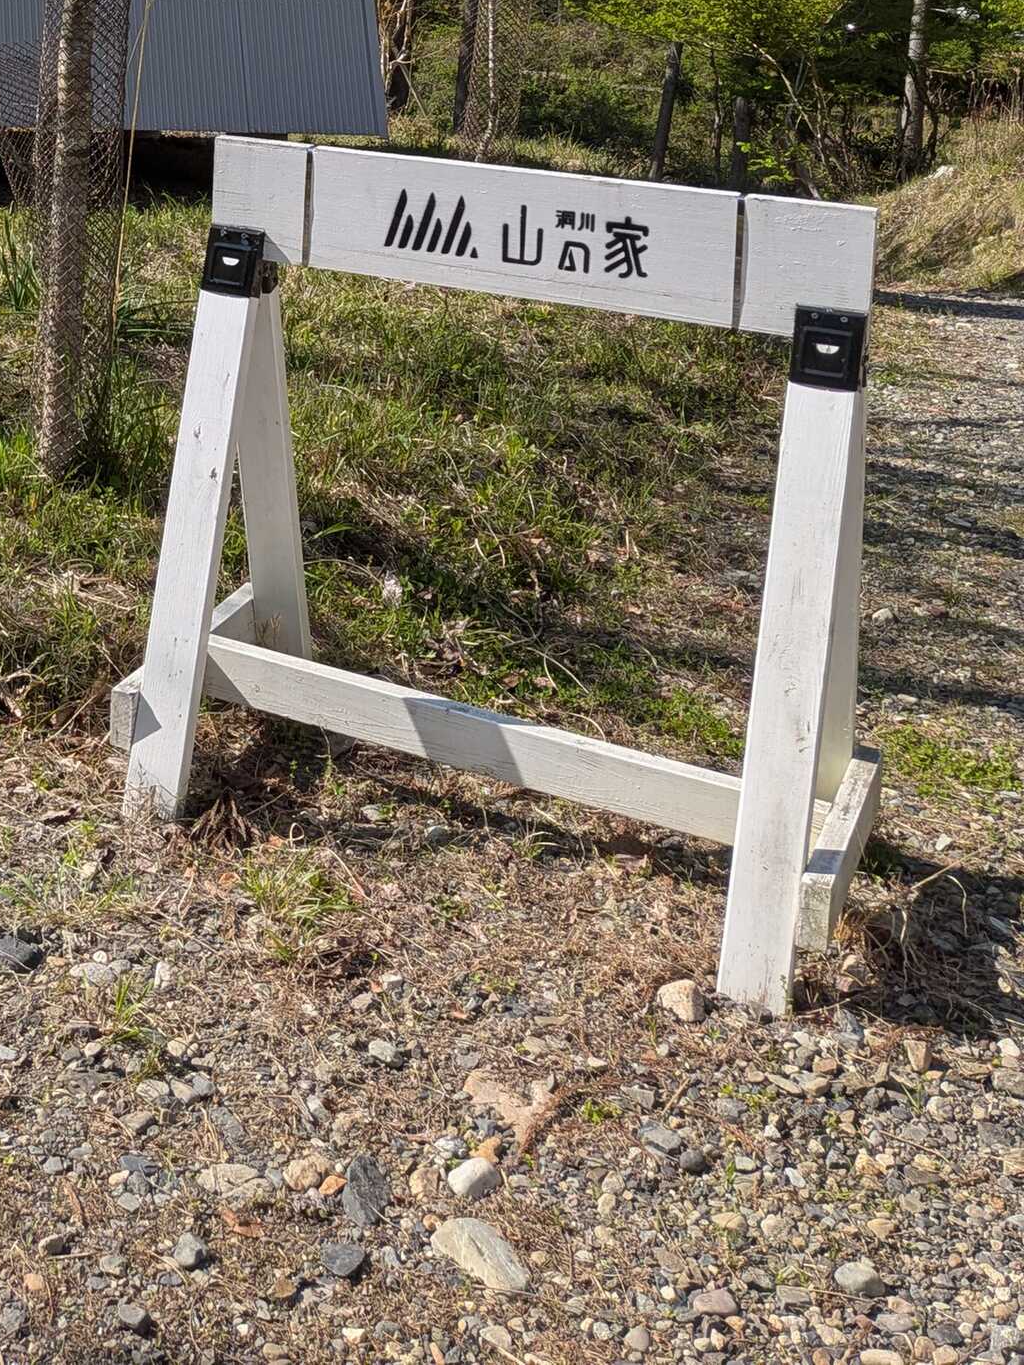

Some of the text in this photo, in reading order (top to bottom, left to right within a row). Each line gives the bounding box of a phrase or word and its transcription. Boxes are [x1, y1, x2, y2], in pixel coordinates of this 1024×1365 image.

[501, 204, 650, 279] 山の家
[555, 209, 595, 233] 洞川
